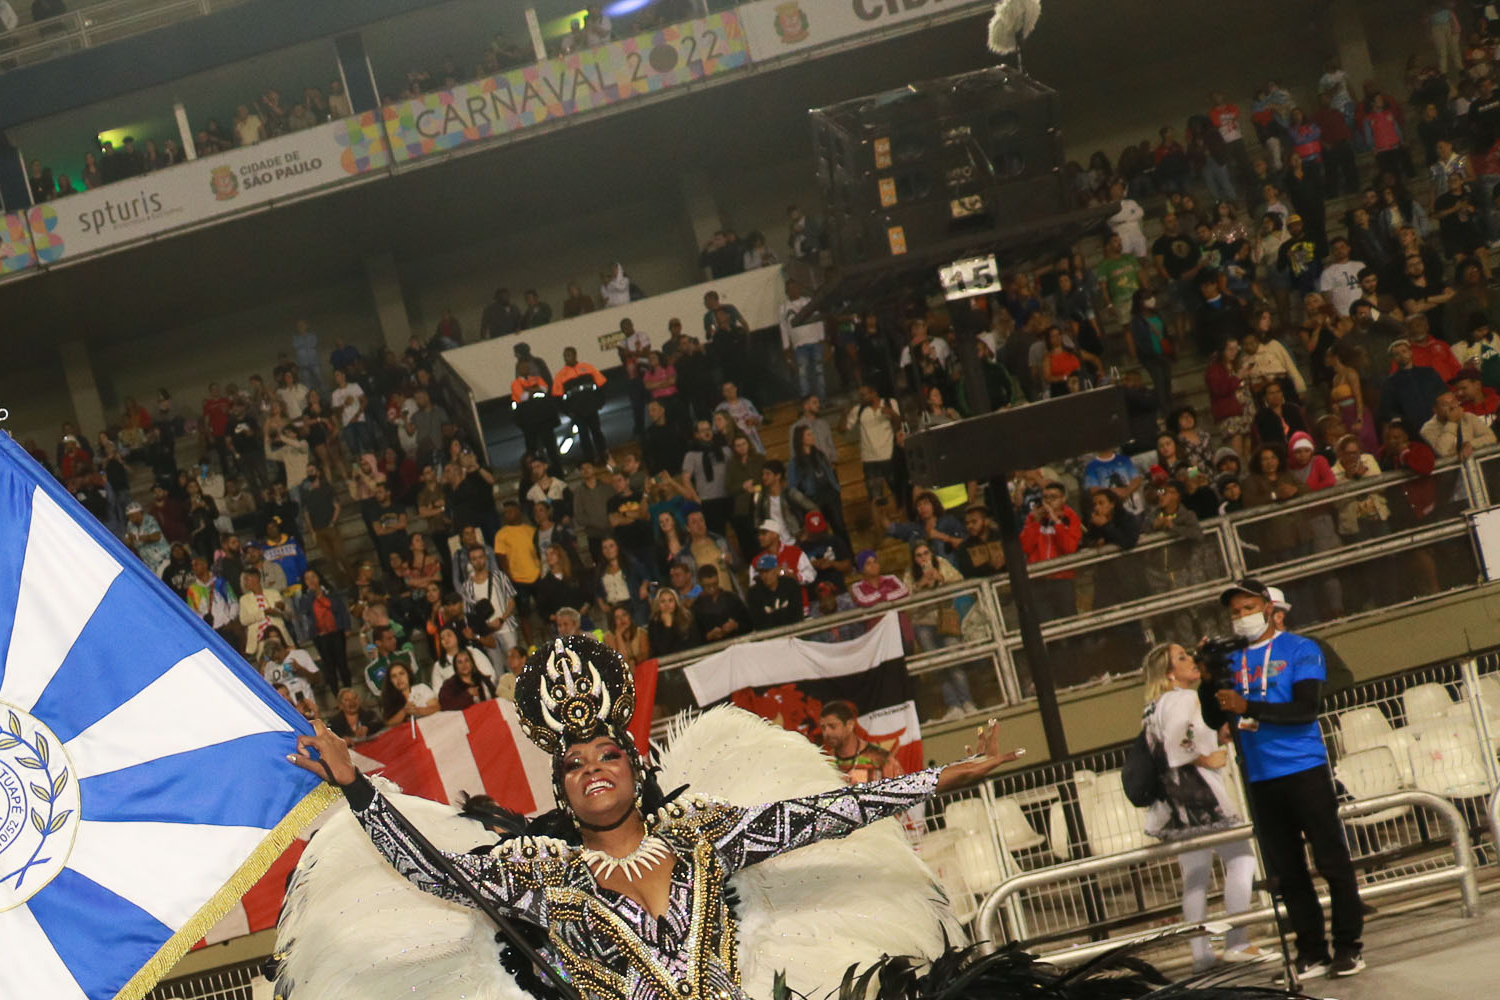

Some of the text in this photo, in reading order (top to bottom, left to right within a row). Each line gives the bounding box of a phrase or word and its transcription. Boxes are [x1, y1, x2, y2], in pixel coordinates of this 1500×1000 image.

[416, 64, 617, 138] CARNAVAL
[240, 151, 299, 177] CIDADE DE
[242, 158, 322, 191] SÃO PAULO
[78, 191, 162, 234] spturis
